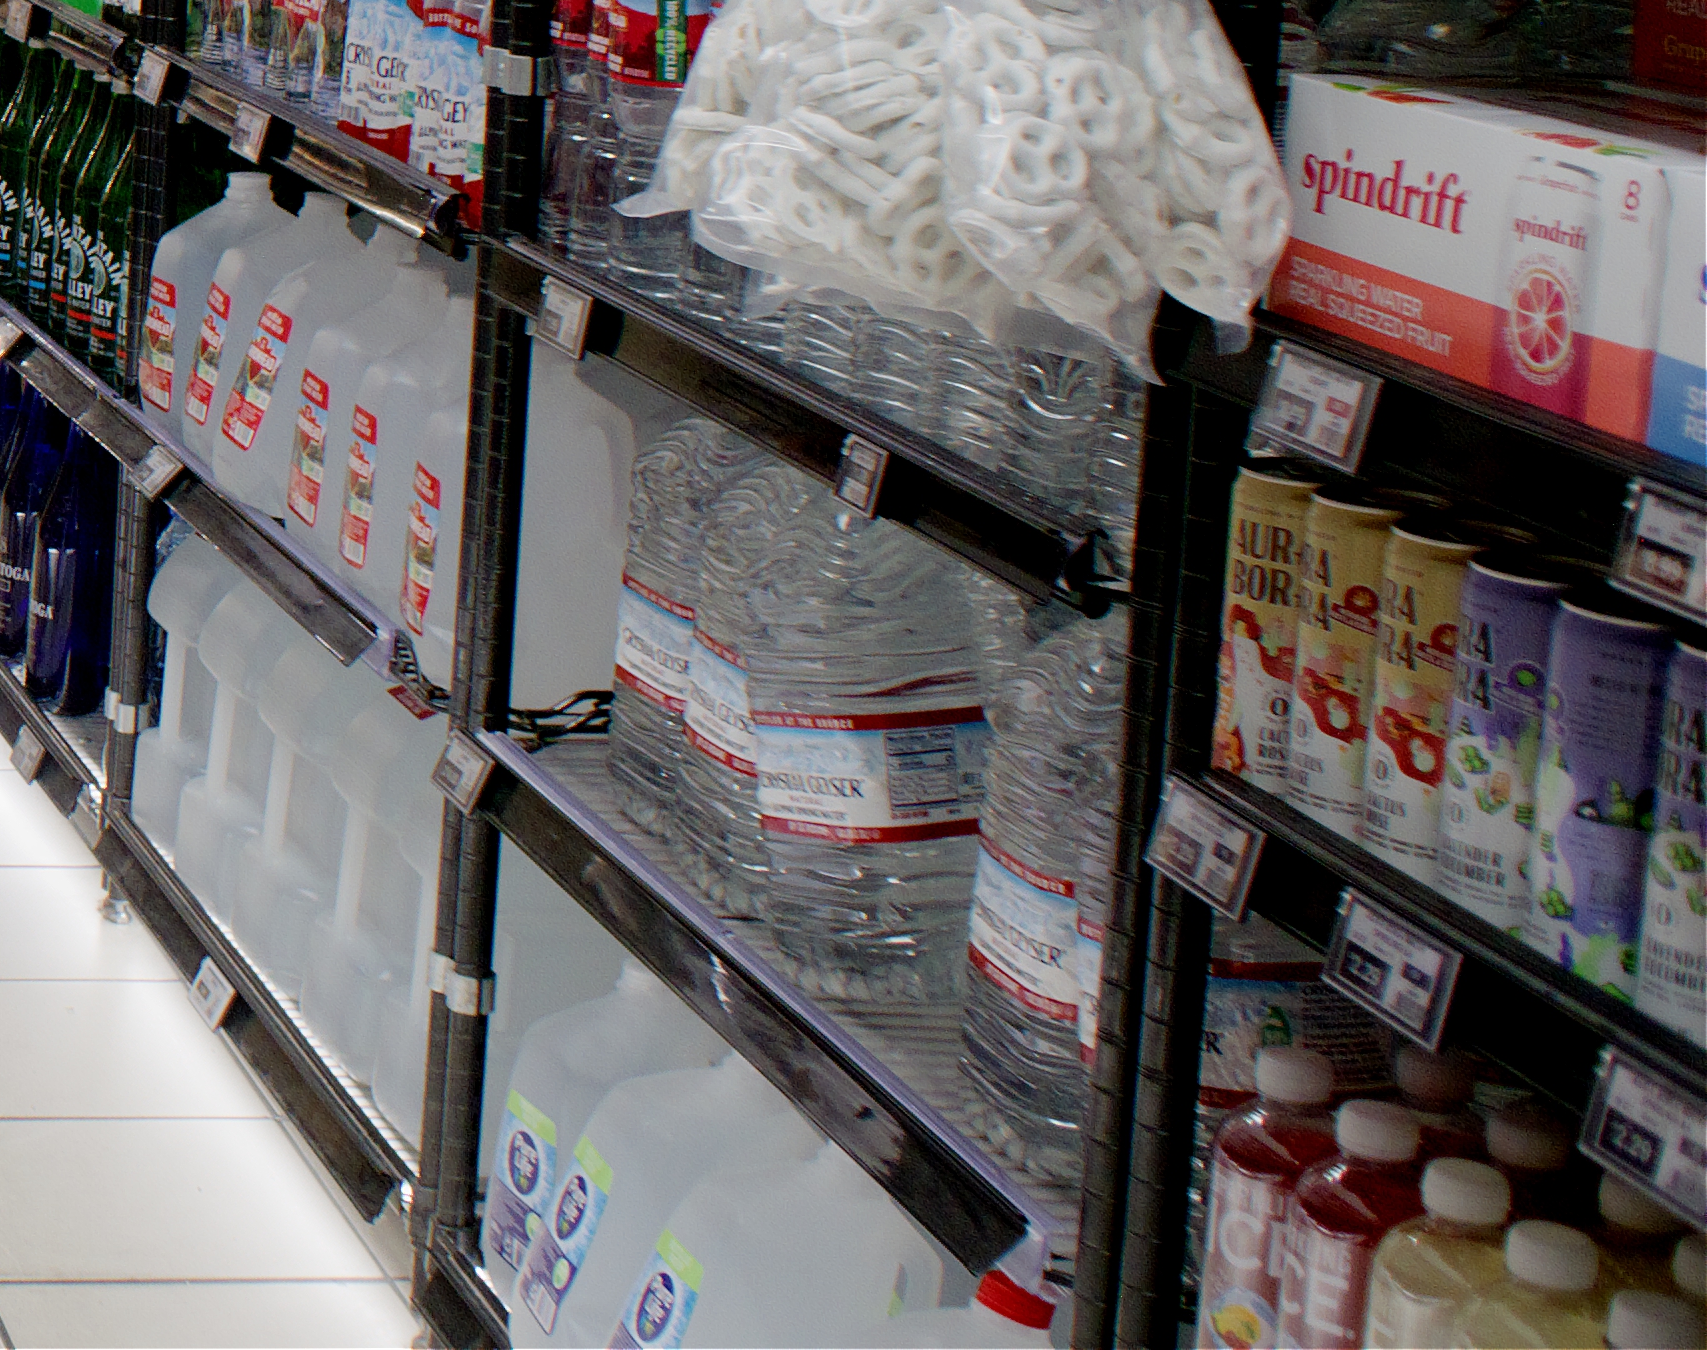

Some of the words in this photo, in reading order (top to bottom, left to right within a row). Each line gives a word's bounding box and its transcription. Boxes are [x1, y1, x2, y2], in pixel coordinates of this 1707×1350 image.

[1300, 147, 1472, 235] spindrift
[1623, 179, 1641, 211] 8
[1289, 281, 1324, 307] REAL
[1325, 292, 1405, 340] SQUEEZED
[1405, 321, 1454, 357] FRUIT
[1290, 254, 1368, 304] SPARKLING
[1370, 281, 1424, 319] WATER
